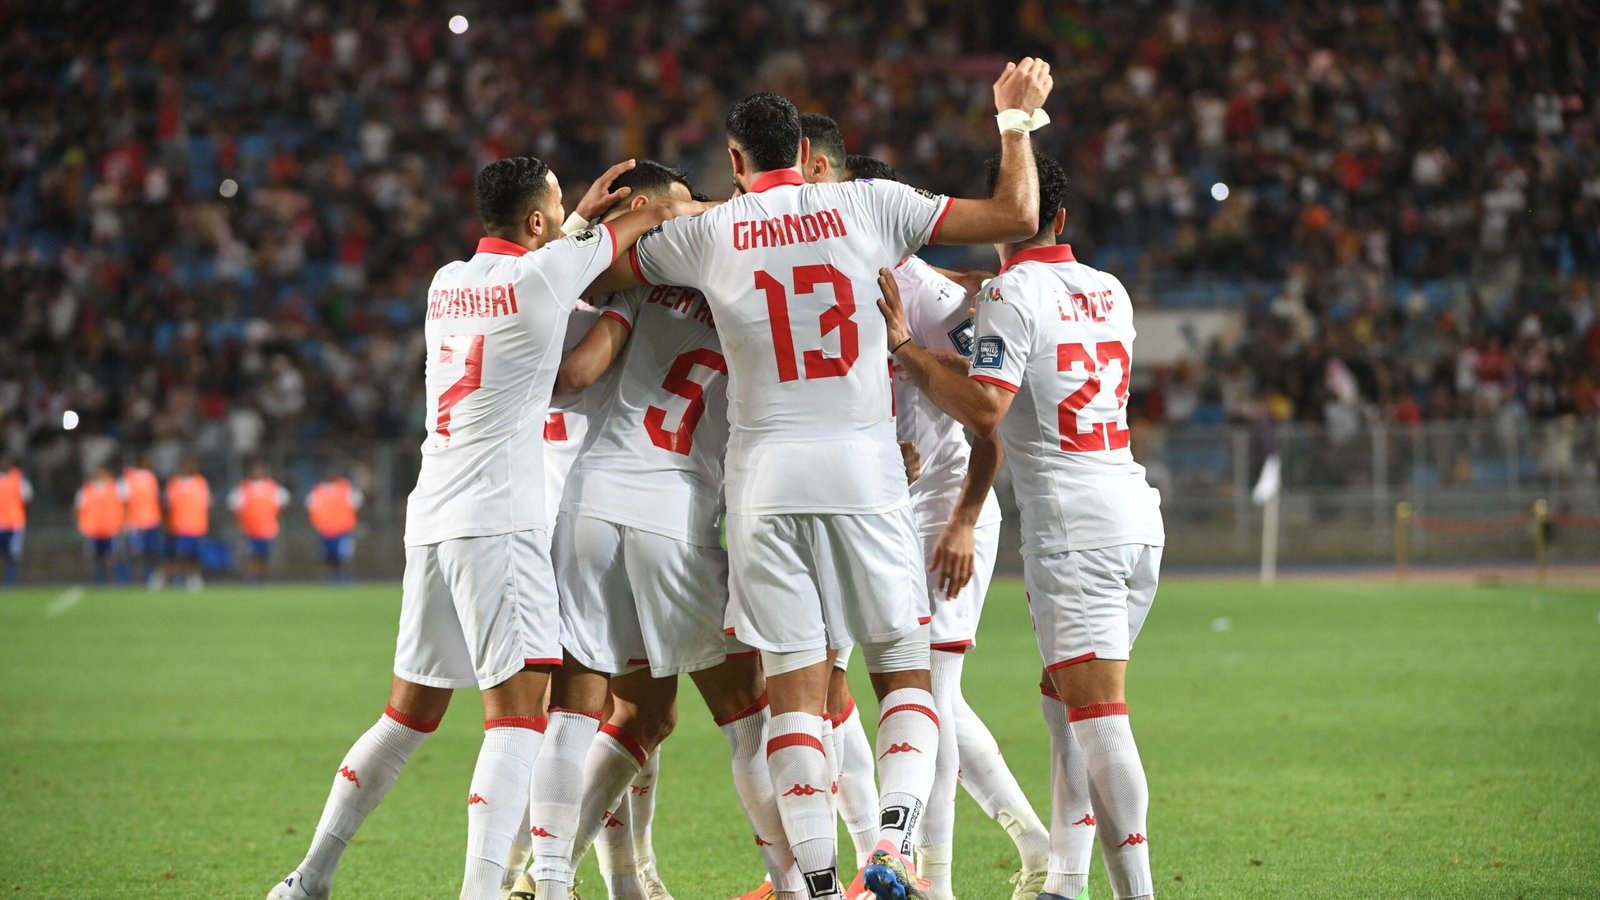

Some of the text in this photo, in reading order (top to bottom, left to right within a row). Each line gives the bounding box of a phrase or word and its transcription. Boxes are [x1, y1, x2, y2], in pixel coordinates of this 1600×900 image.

[733, 208, 847, 251] GHANDRI
[427, 283, 518, 320] ACHOURI
[754, 264, 859, 382] 13
[434, 335, 484, 448] 7
[643, 348, 727, 456] 5
[1057, 341, 1130, 452] 23
